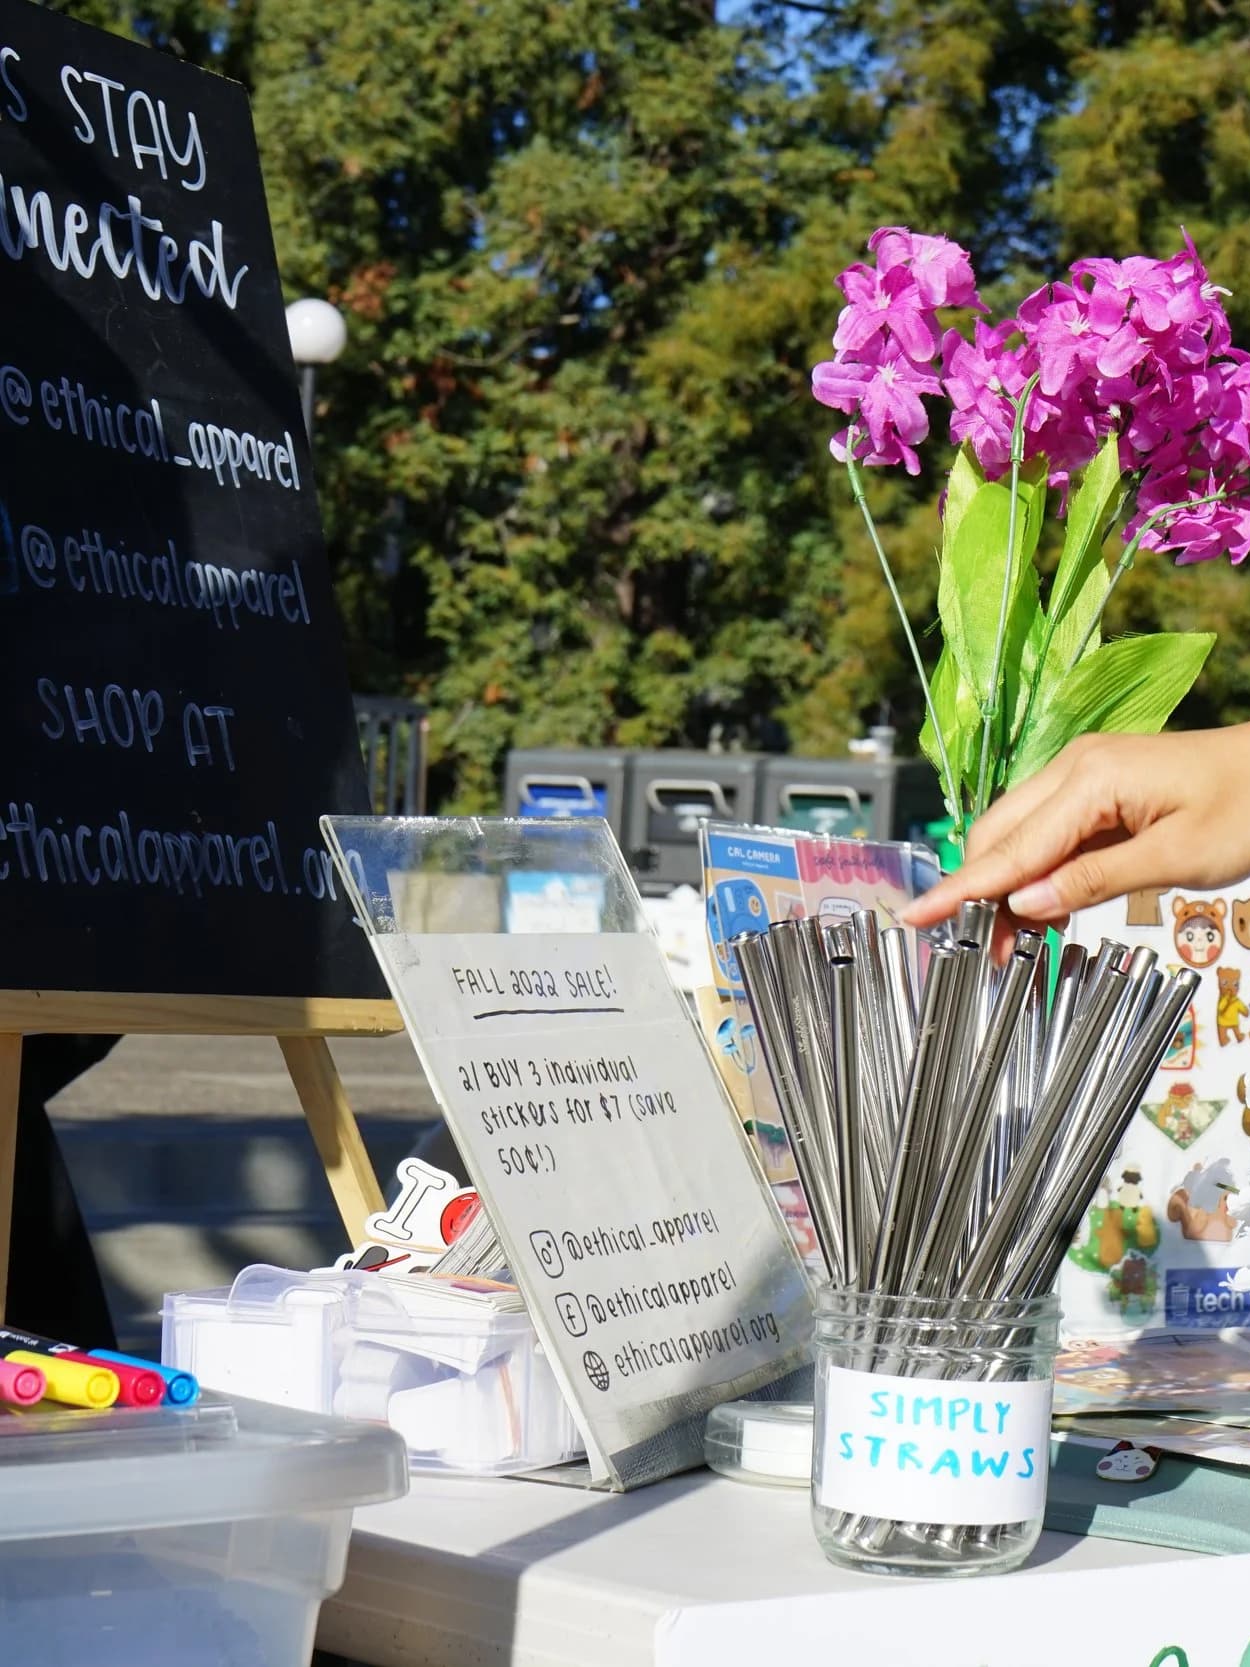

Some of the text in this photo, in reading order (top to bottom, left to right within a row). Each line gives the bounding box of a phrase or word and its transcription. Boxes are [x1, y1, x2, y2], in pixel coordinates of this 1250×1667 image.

[61, 65, 206, 191] STAY
[0, 366, 301, 490] @ethical_apparel
[21, 524, 311, 630] @ethicalapparel
[37, 677, 235, 772] SHOP AT
[728, 846, 745, 858] CAL
[746, 849, 781, 865] CAMERA
[452, 964, 617, 999] FALL 2022 SALE!
[484, 1058, 524, 1088] BUY
[528, 1060, 541, 1087] 3
[544, 1055, 638, 1086] individual
[481, 1091, 677, 1135] stickers for $7 (save
[498, 1144, 556, 1175] 50¢!)
[562, 1208, 720, 1261] @ethical_apparel
[586, 1260, 737, 1324] @ethicalapparel
[1194, 1287, 1245, 1313] tech
[614, 1311, 780, 1377] ethicalapparel.org
[870, 1391, 1011, 1435] SIMPLY
[840, 1432, 1035, 1479] STRAWS
